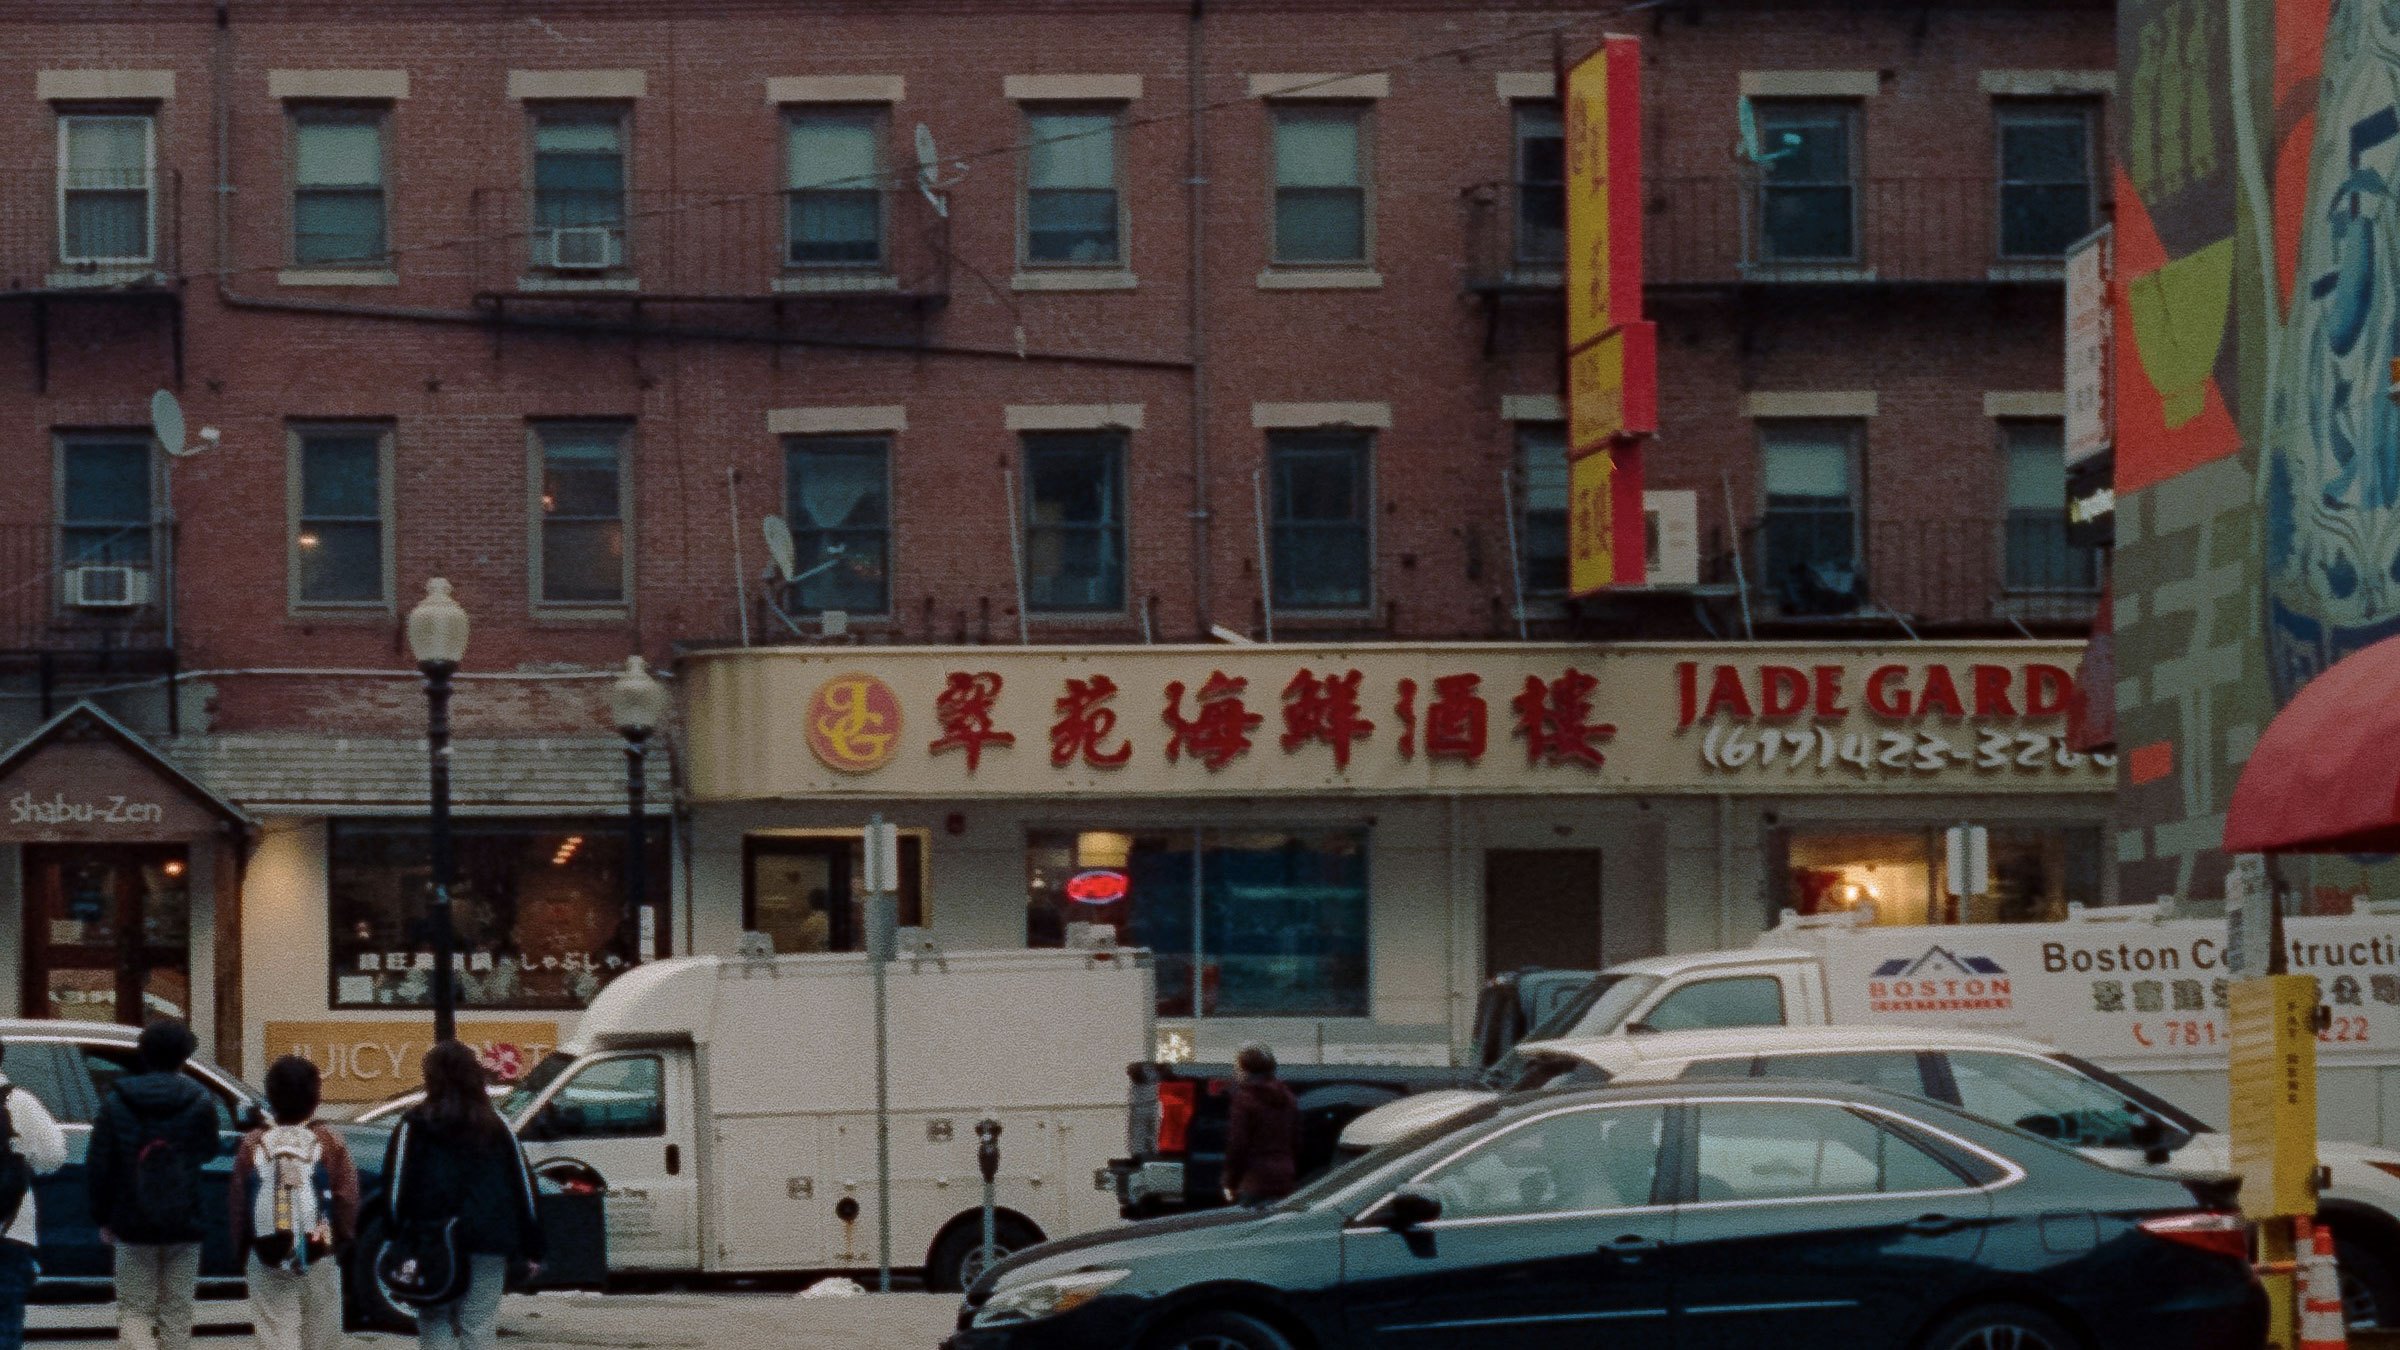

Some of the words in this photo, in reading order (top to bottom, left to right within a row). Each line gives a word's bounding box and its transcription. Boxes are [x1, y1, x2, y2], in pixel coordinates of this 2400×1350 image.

[1676, 661, 1848, 728] JADE
[9, 791, 163, 824] Shabu-Zen
[2042, 942, 2180, 973] Boston
[2191, 934, 2400, 970] Ctructi
[1868, 978, 2011, 998] BOSTON
